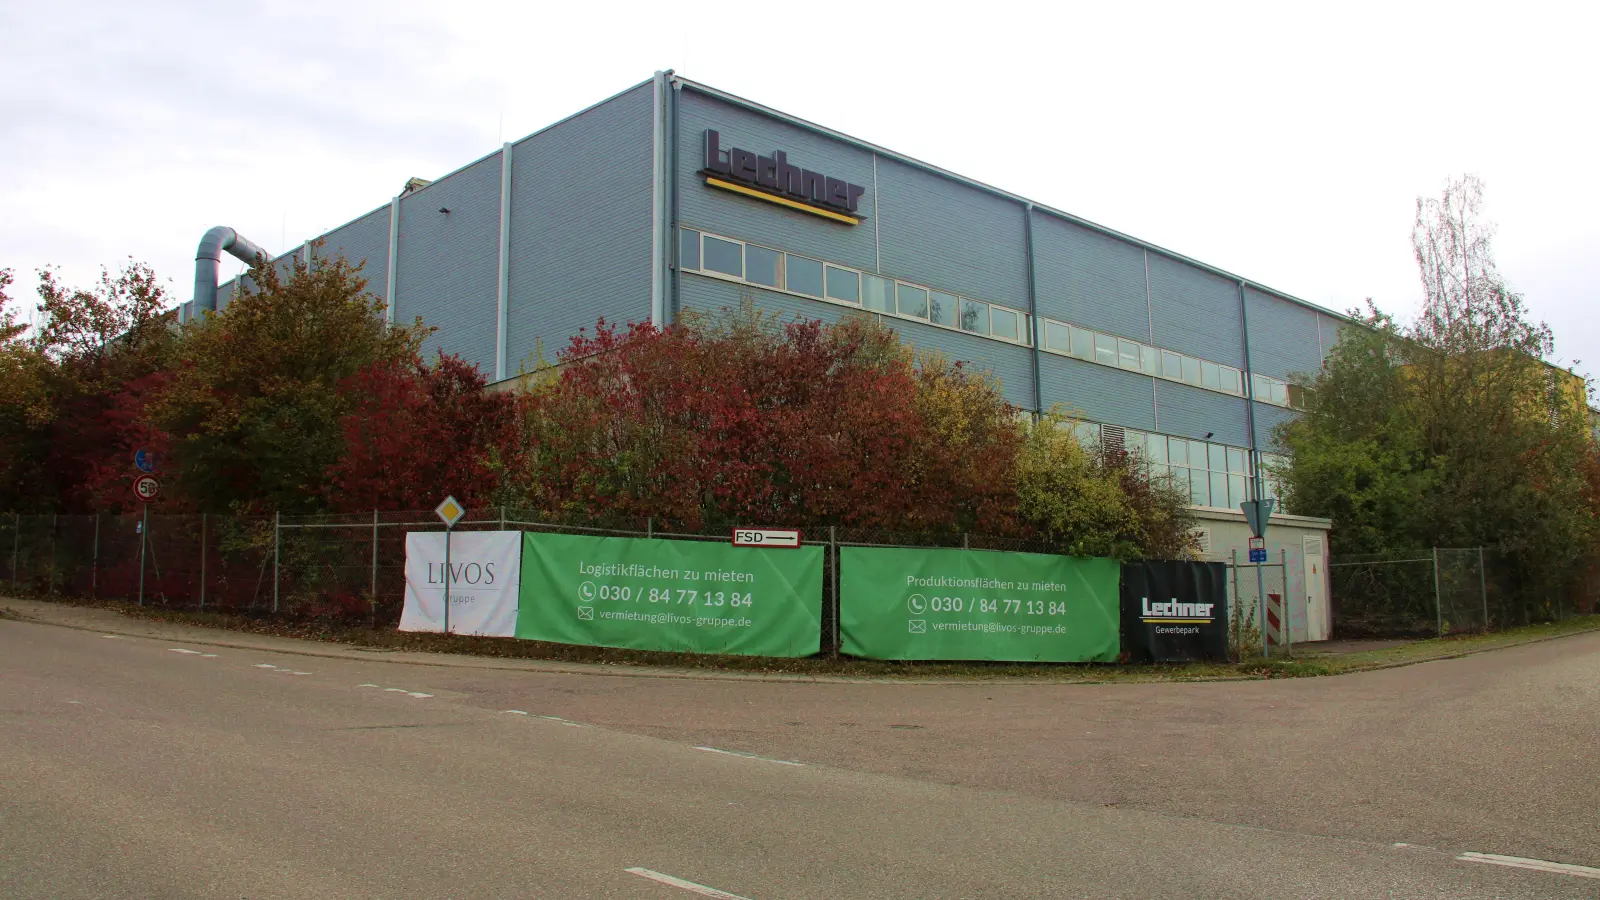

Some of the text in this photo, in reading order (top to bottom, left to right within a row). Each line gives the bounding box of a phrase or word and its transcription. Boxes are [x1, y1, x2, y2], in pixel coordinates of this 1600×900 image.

[703, 128, 866, 212] Lechner
[736, 531, 763, 543] FSD
[428, 562, 495, 585] LIVOS
[580, 561, 754, 583] Logistikflächen zu mieten
[907, 576, 1067, 592] Produktionsflächen zu mieten
[600, 585, 753, 607] 030 / 84 77 13 84
[931, 597, 1067, 615] 030 / 84 77 13 84
[1142, 597, 1214, 617] Lechner
[600, 610, 752, 627] vermietung@livos-gruppe.de
[932, 620, 1067, 634] vermietung@livos-gruppe.de
[1155, 625, 1200, 635] Gewerbepark
